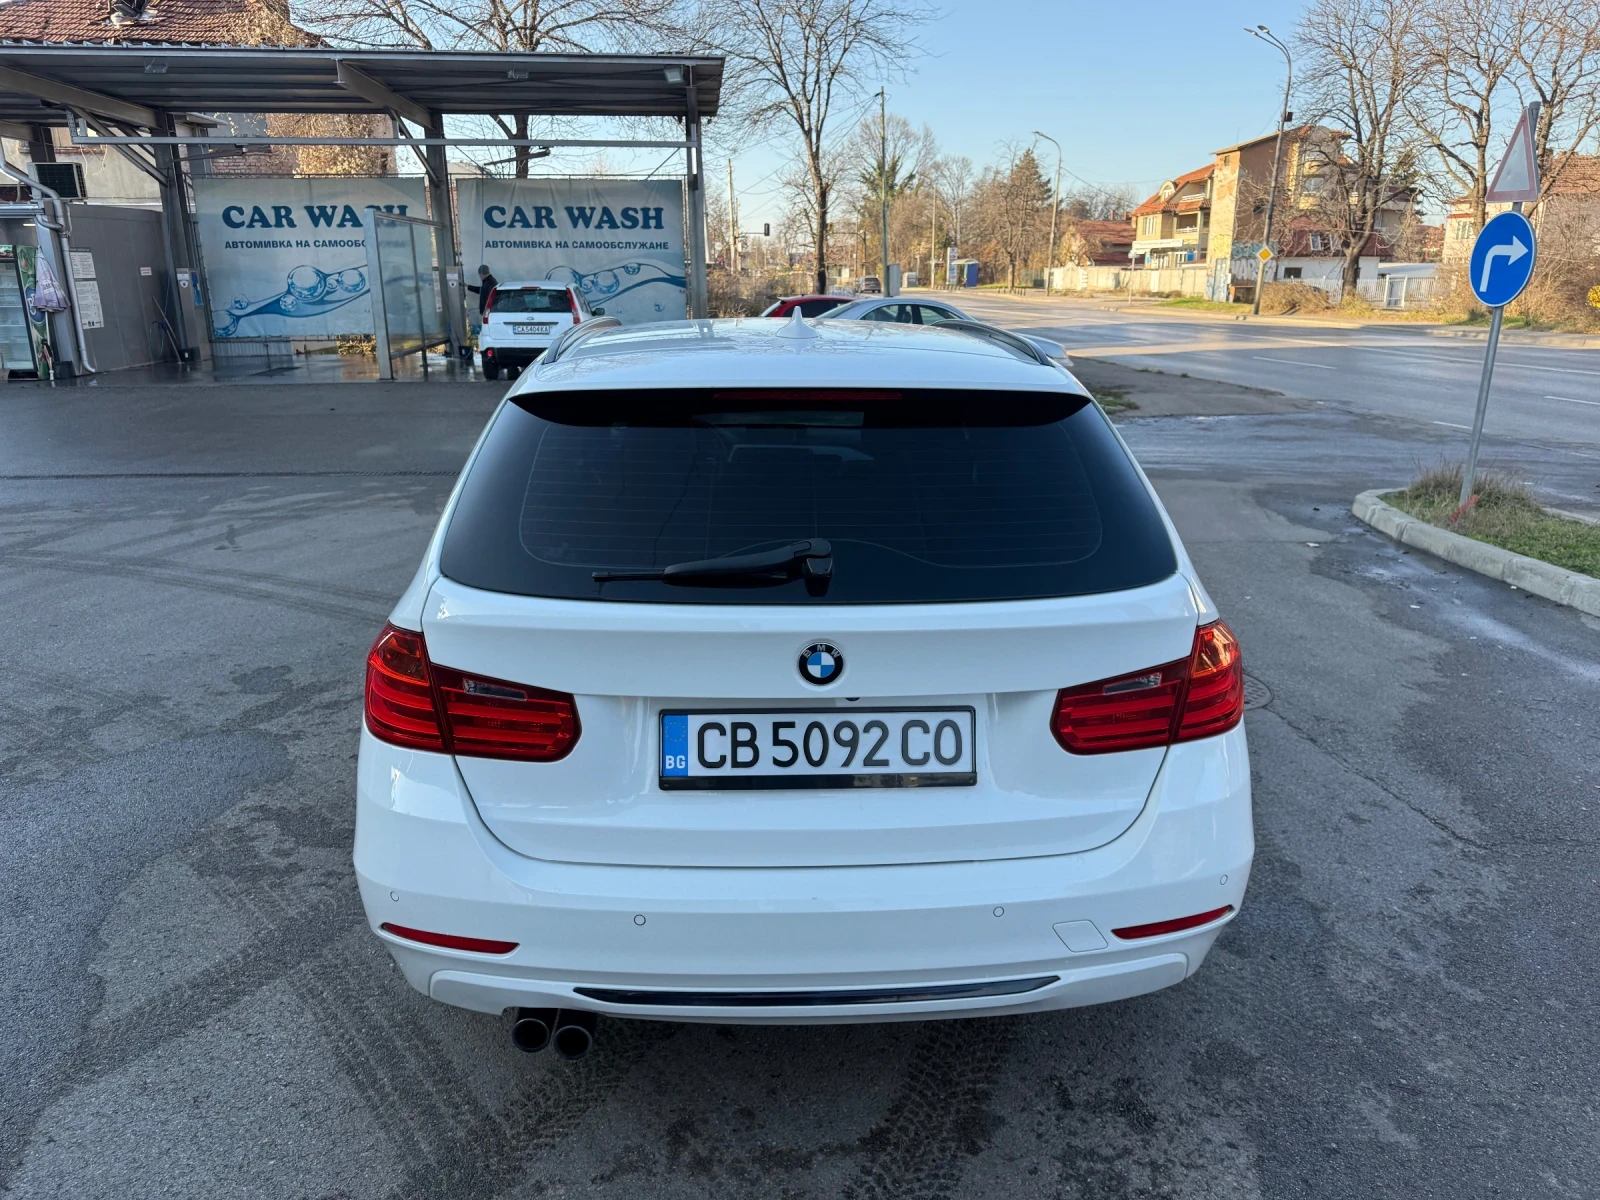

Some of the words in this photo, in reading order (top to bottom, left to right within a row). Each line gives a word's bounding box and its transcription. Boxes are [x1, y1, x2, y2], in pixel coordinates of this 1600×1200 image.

[222, 205, 297, 228] CAR
[484, 205, 557, 229] CAR
[565, 206, 664, 229] WASH
[225, 240, 293, 249] АВТОМИВКА
[296, 240, 309, 248] НА
[485, 240, 552, 249] АВТОМИВКА
[555, 240, 569, 249] НА
[572, 241, 669, 250] САМООБСЛУЖАНЕ
[802, 644, 841, 659] BMW
[665, 755, 686, 769] BG
